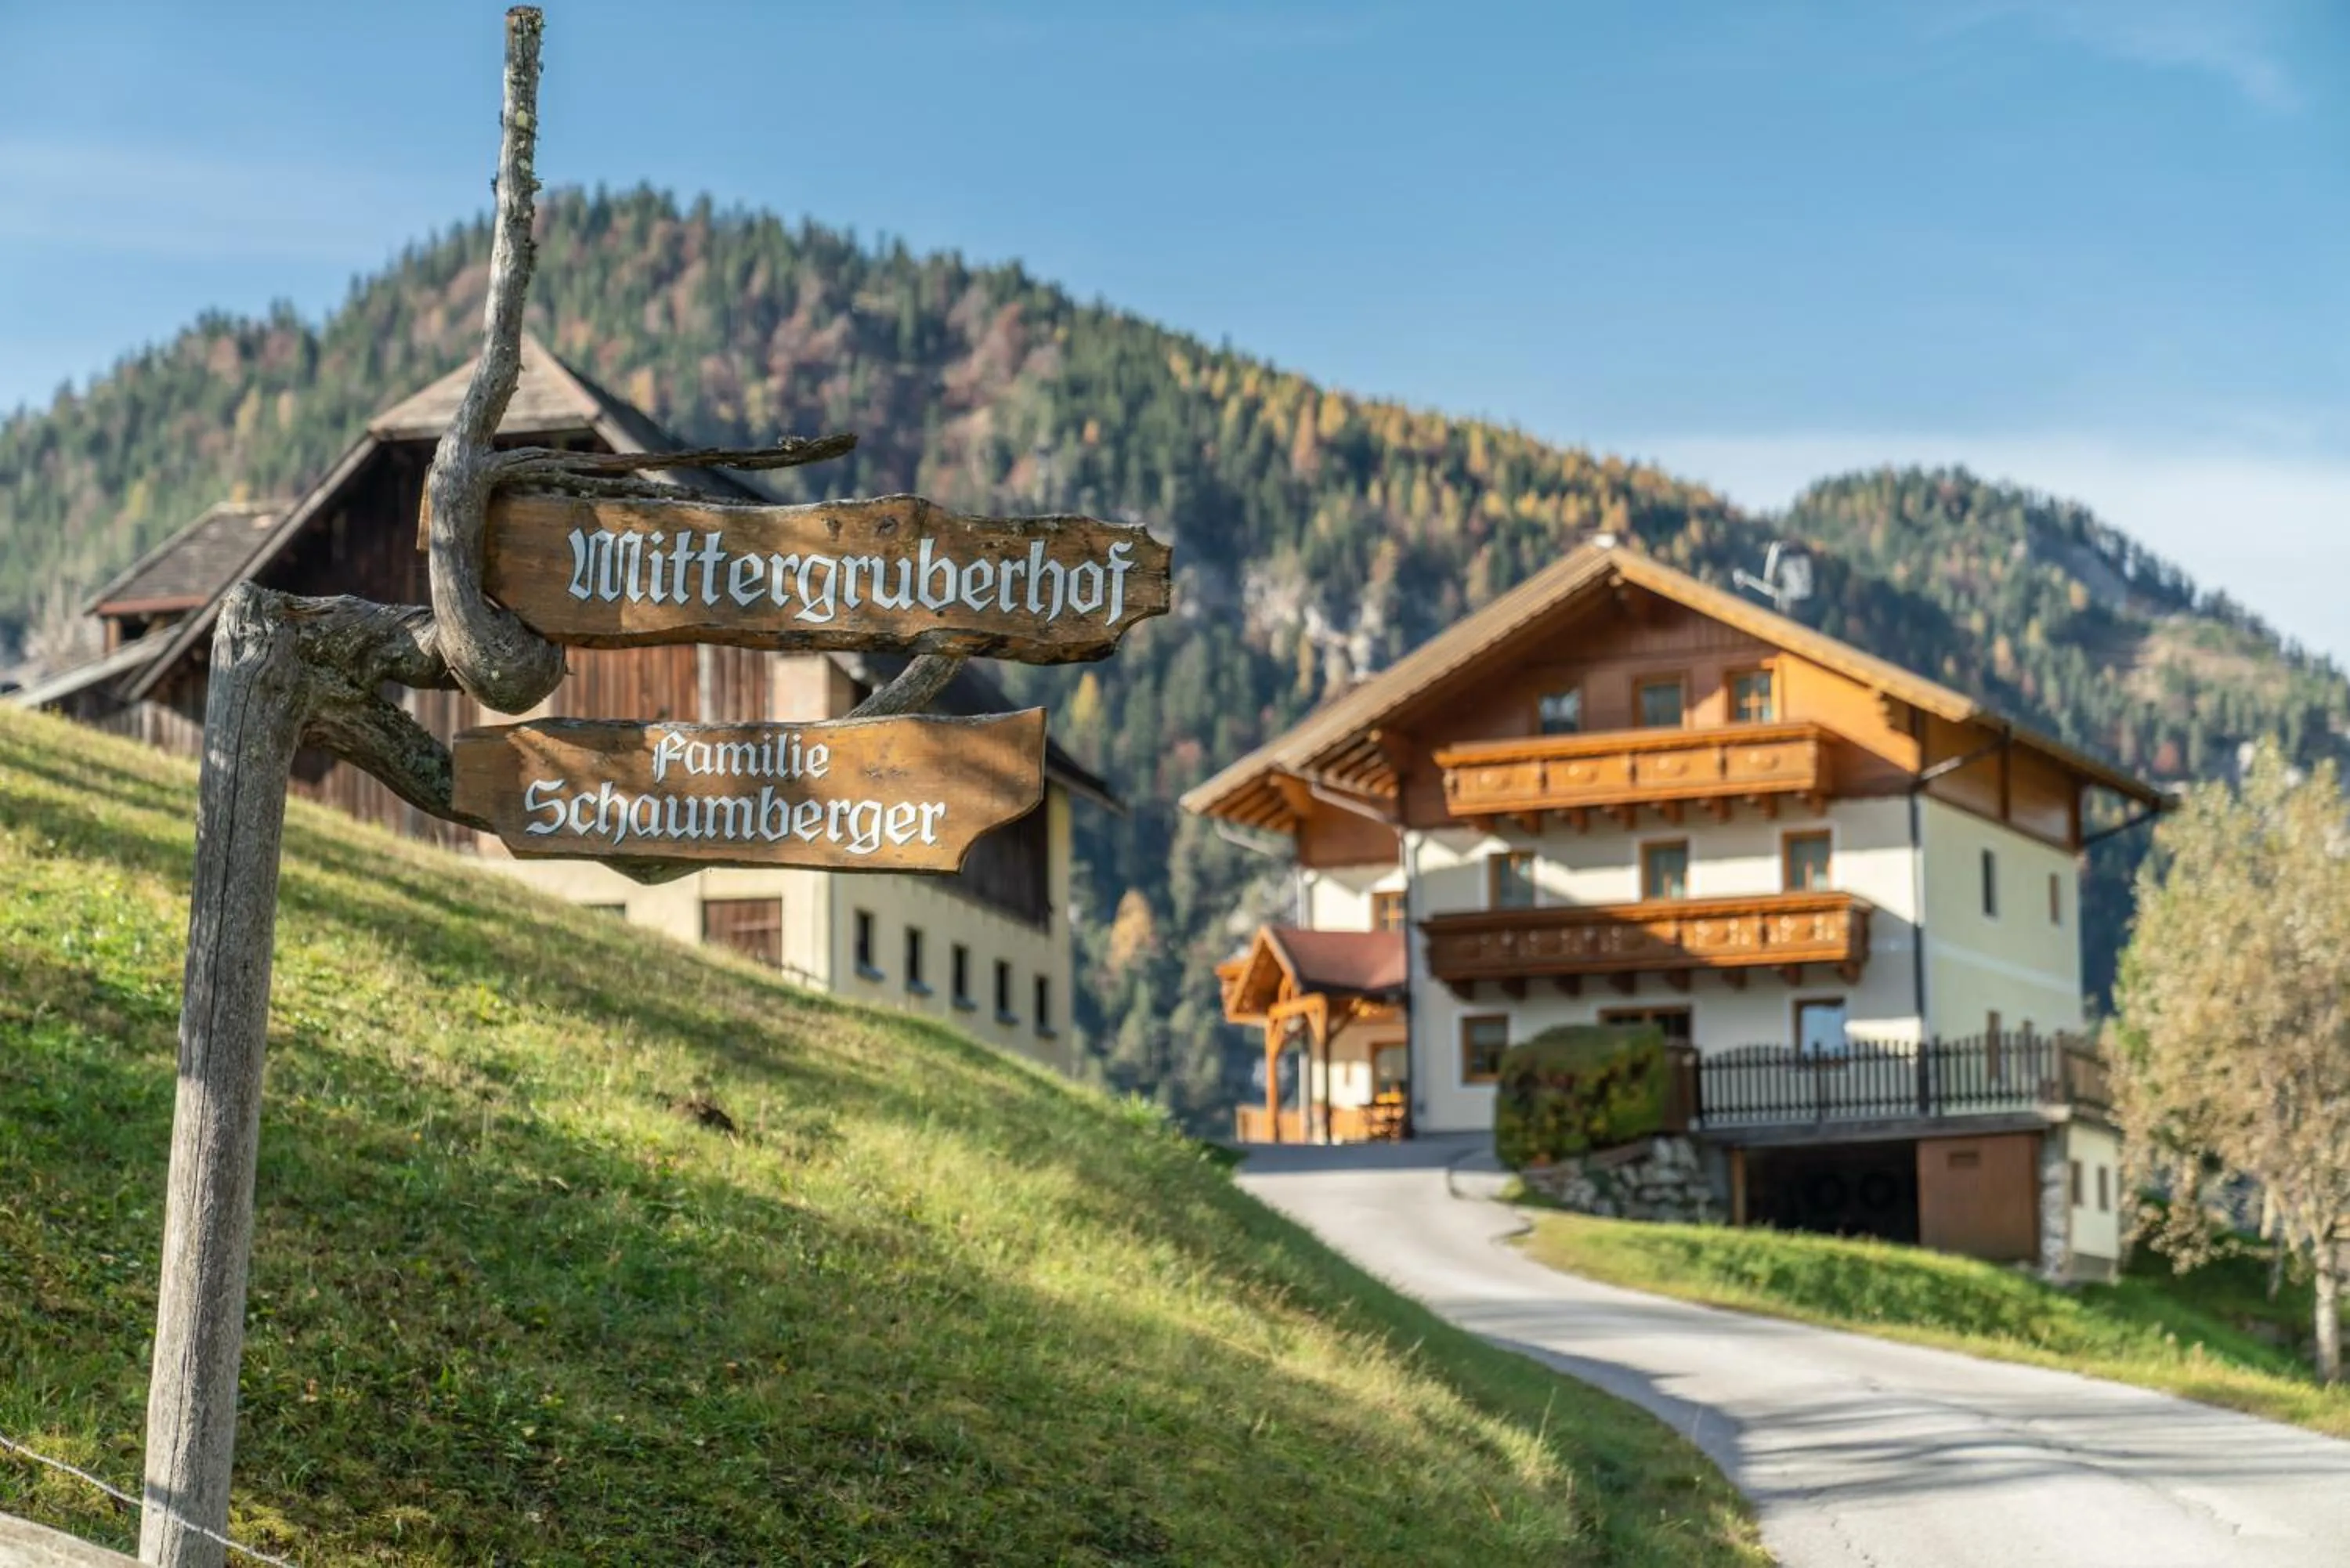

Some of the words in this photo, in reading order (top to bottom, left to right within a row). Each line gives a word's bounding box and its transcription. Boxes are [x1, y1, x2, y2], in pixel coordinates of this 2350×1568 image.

[567, 526, 1133, 626] Mittergruberhof
[652, 729, 830, 782] Familie
[524, 779, 946, 855] Schaumberger
